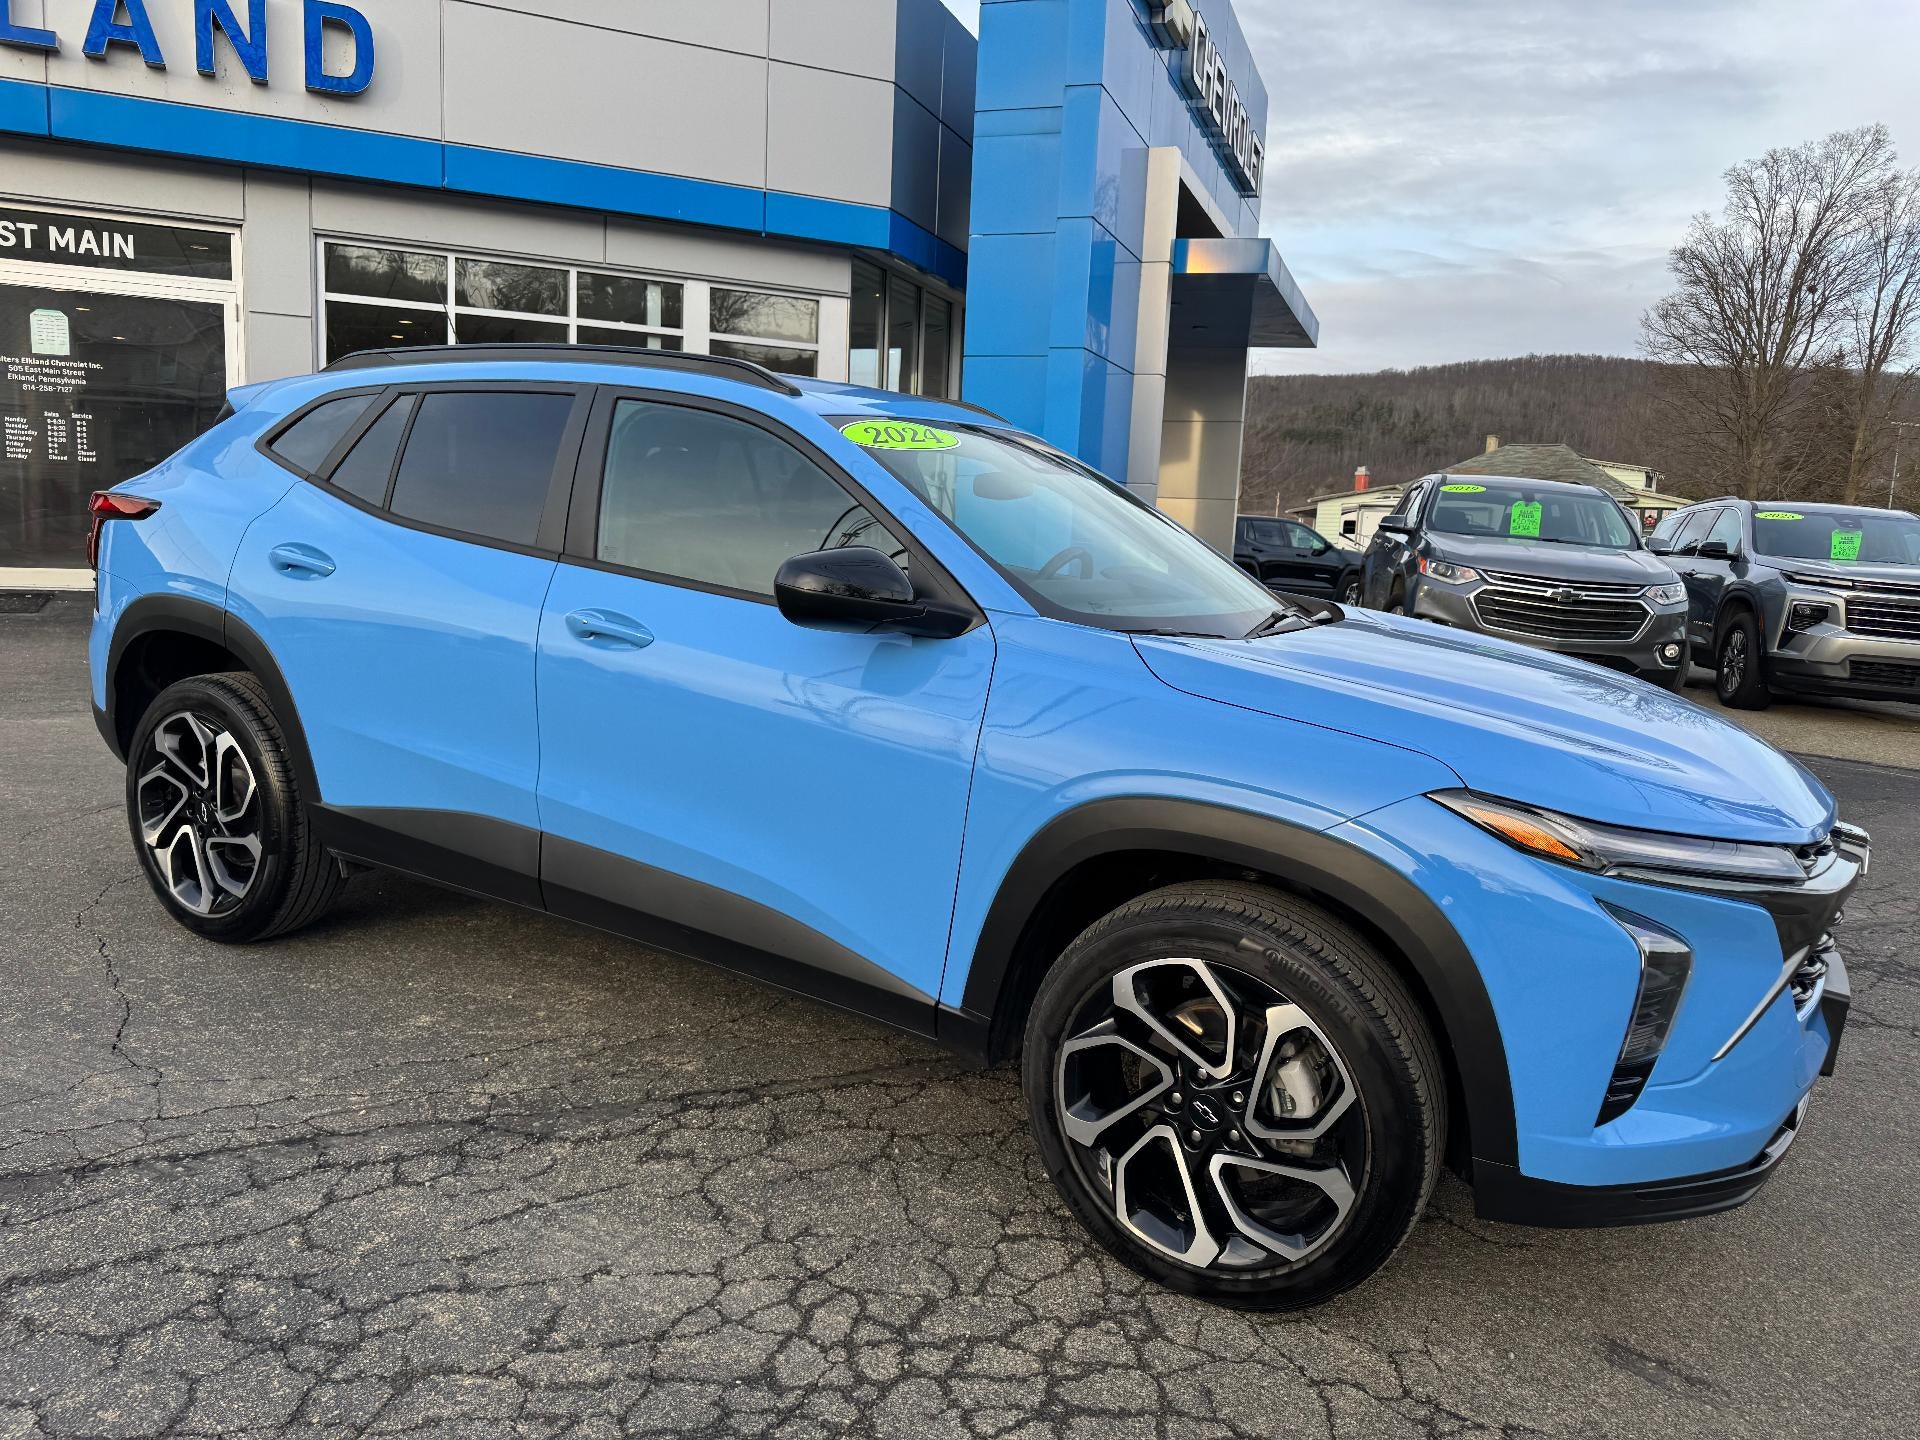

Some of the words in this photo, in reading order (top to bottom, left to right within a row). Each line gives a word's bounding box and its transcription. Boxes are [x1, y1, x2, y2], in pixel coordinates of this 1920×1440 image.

[1192, 10, 1265, 197] CHEVROLET
[0, 220, 38, 249] ST
[48, 225, 135, 260] MAIN
[0, 355, 19, 364] lters
[21, 357, 49, 367] Elkland
[51, 360, 88, 368] Chevrolet
[88, 362, 104, 370] Inc.
[8, 364, 24, 372] 505
[24, 366, 42, 374] East
[42, 367, 61, 375] Main
[62, 368, 85, 377] Street
[7, 373, 37, 382] Elkland,
[38, 375, 87, 385] Pennsylvania
[71, 412, 93, 420] Service
[863, 426, 944, 444] 2024
